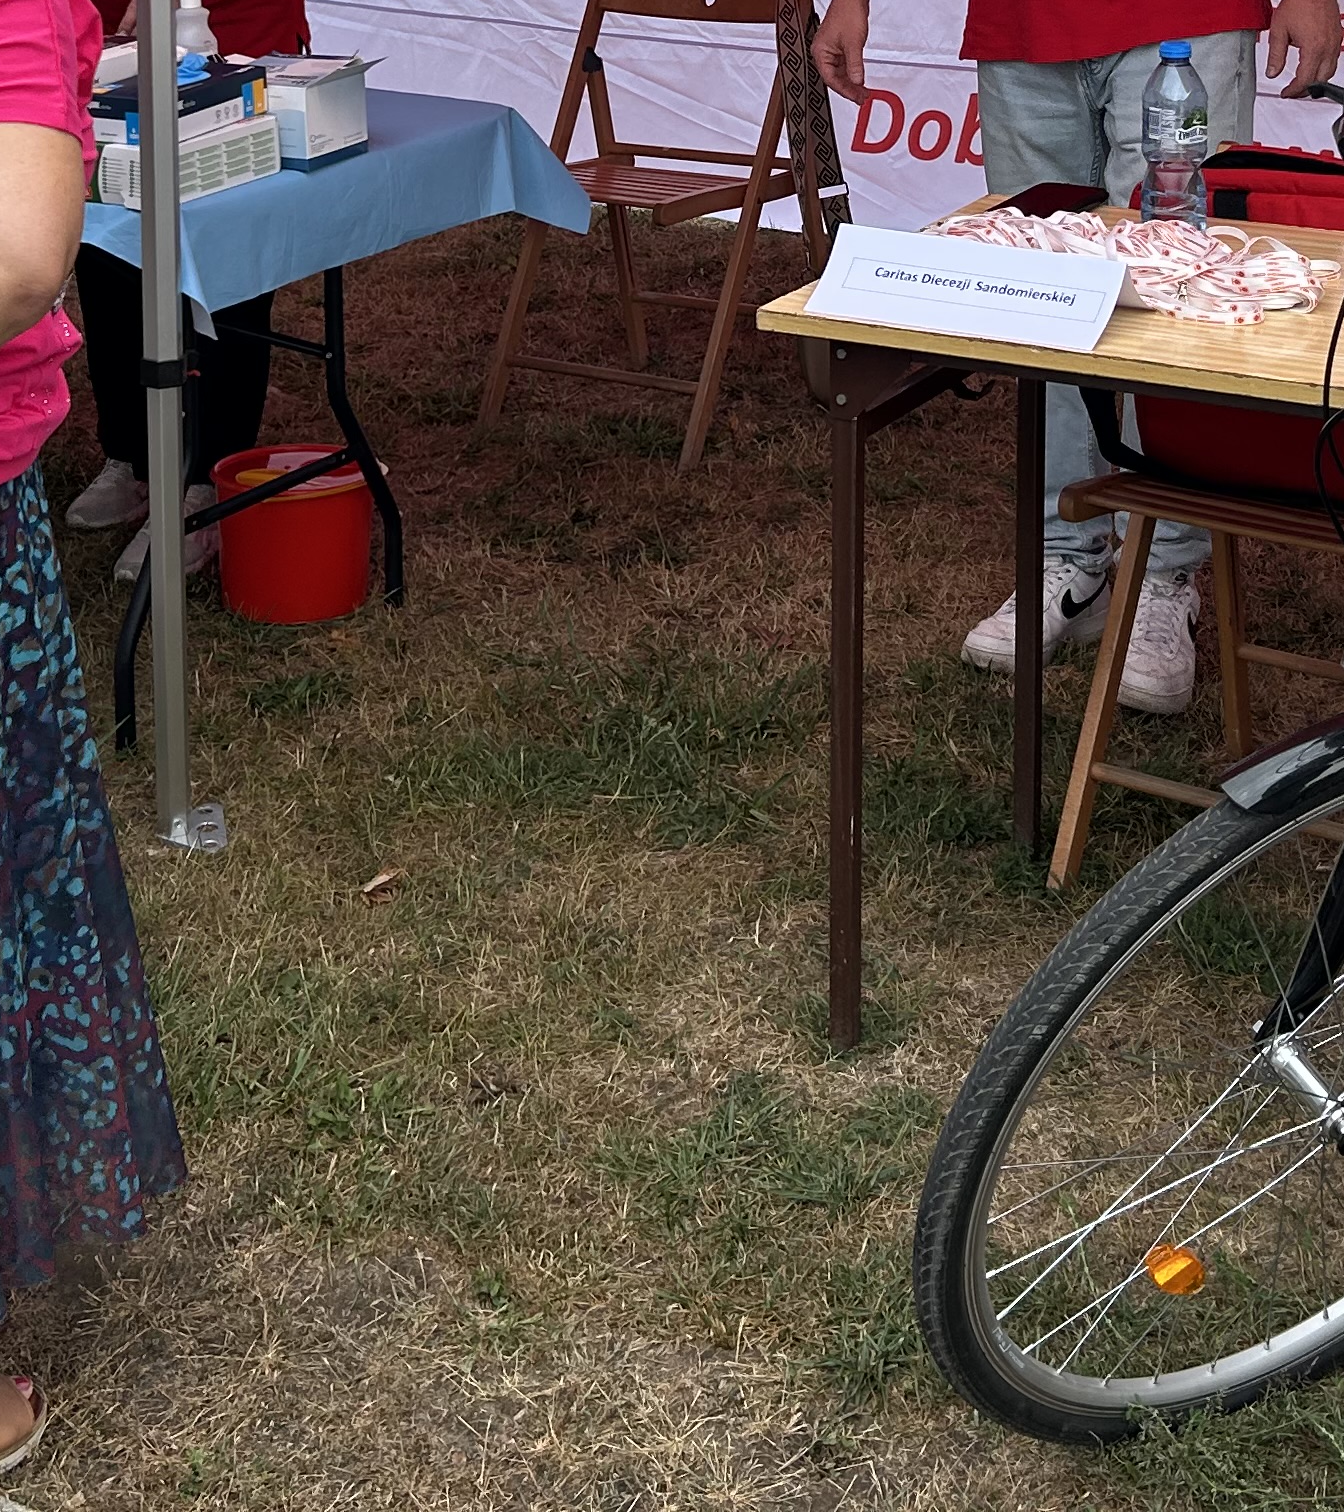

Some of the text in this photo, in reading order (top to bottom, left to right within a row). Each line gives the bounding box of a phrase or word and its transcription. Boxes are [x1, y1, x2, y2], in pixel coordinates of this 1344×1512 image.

[874, 266, 1076, 306] Caritas Diecezji Sandomierskiej
